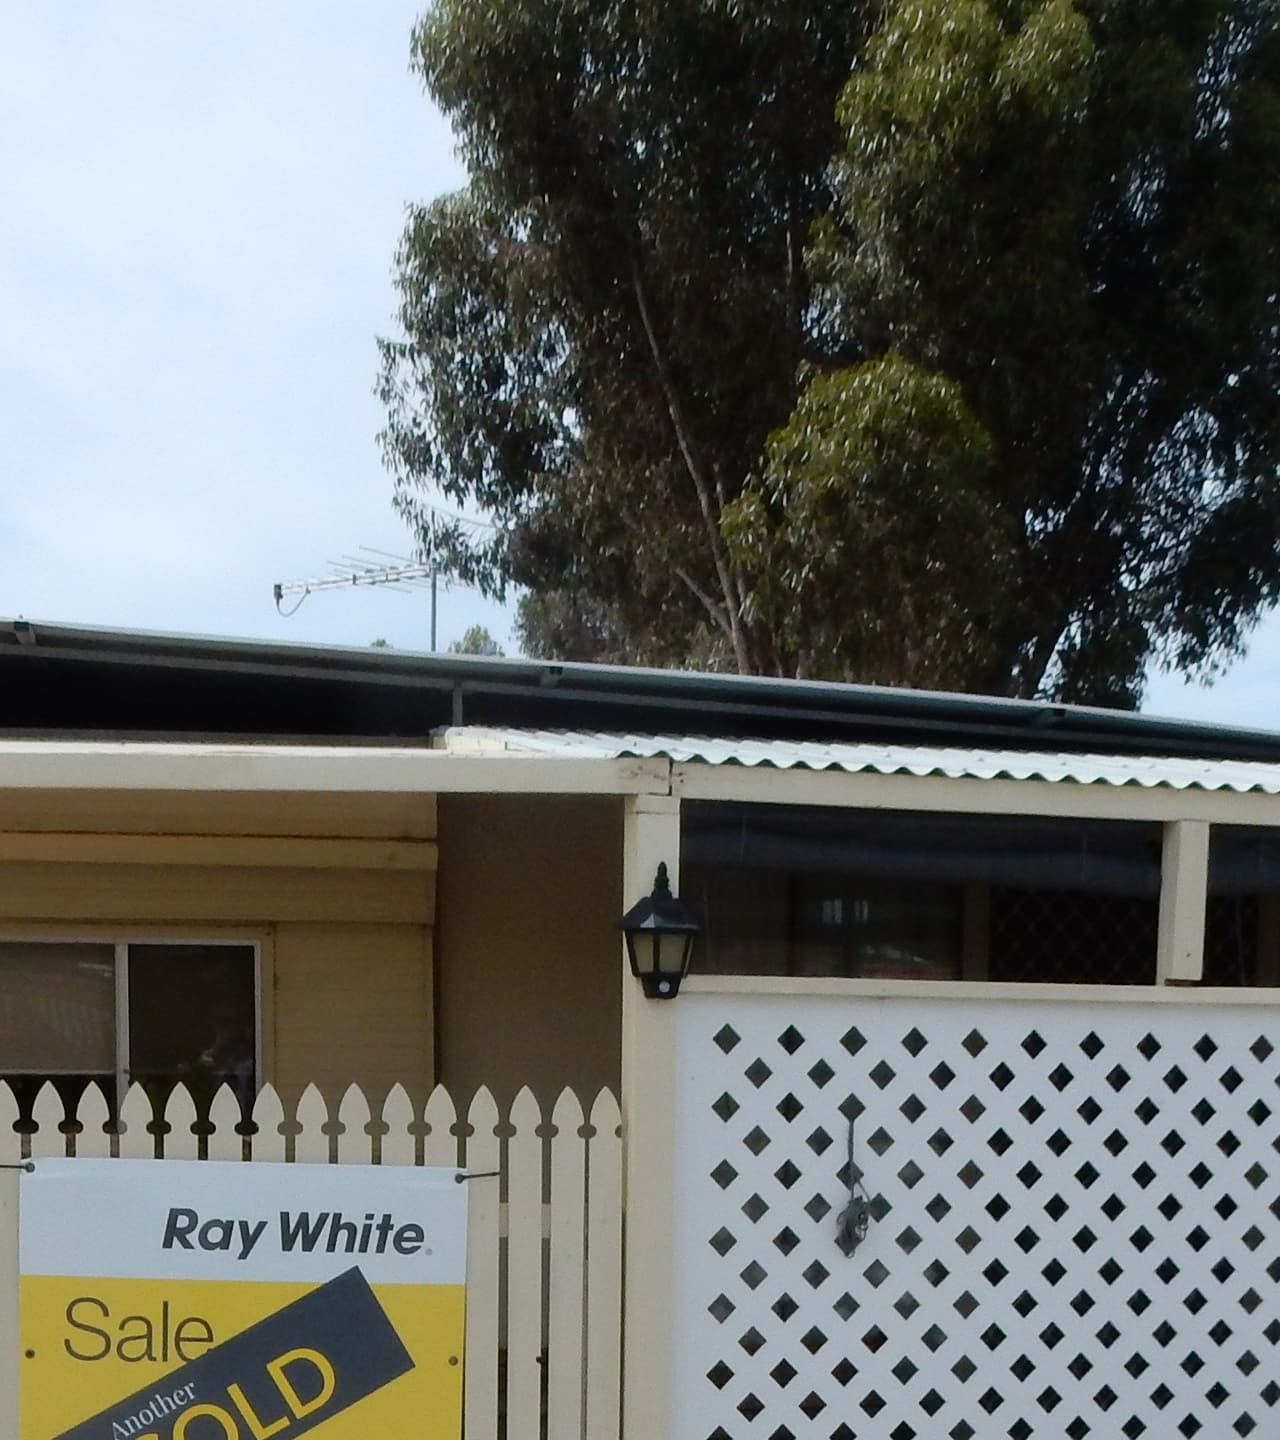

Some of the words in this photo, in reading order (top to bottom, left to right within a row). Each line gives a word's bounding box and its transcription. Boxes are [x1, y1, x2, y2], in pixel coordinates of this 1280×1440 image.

[161, 1207, 268, 1260] Ray
[279, 1210, 425, 1255] White
[63, 1296, 214, 1362] Sale
